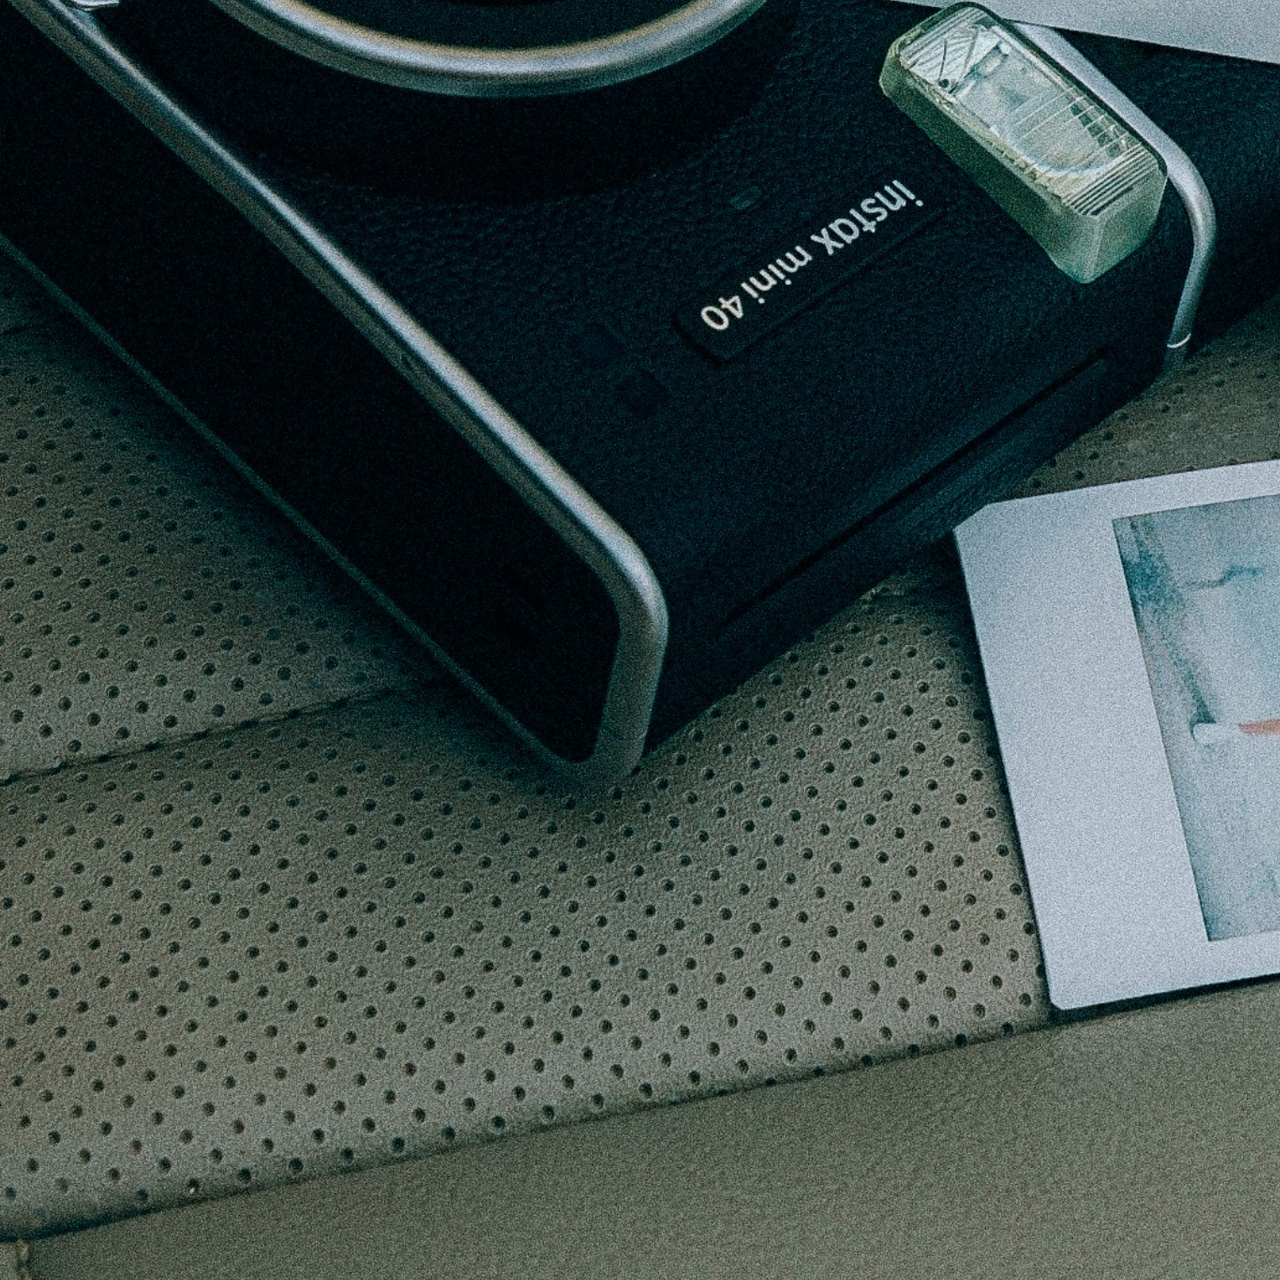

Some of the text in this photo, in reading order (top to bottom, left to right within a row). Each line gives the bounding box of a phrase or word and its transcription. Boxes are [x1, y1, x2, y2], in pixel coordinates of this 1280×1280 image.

[700, 178, 925, 331] instax mini 40
